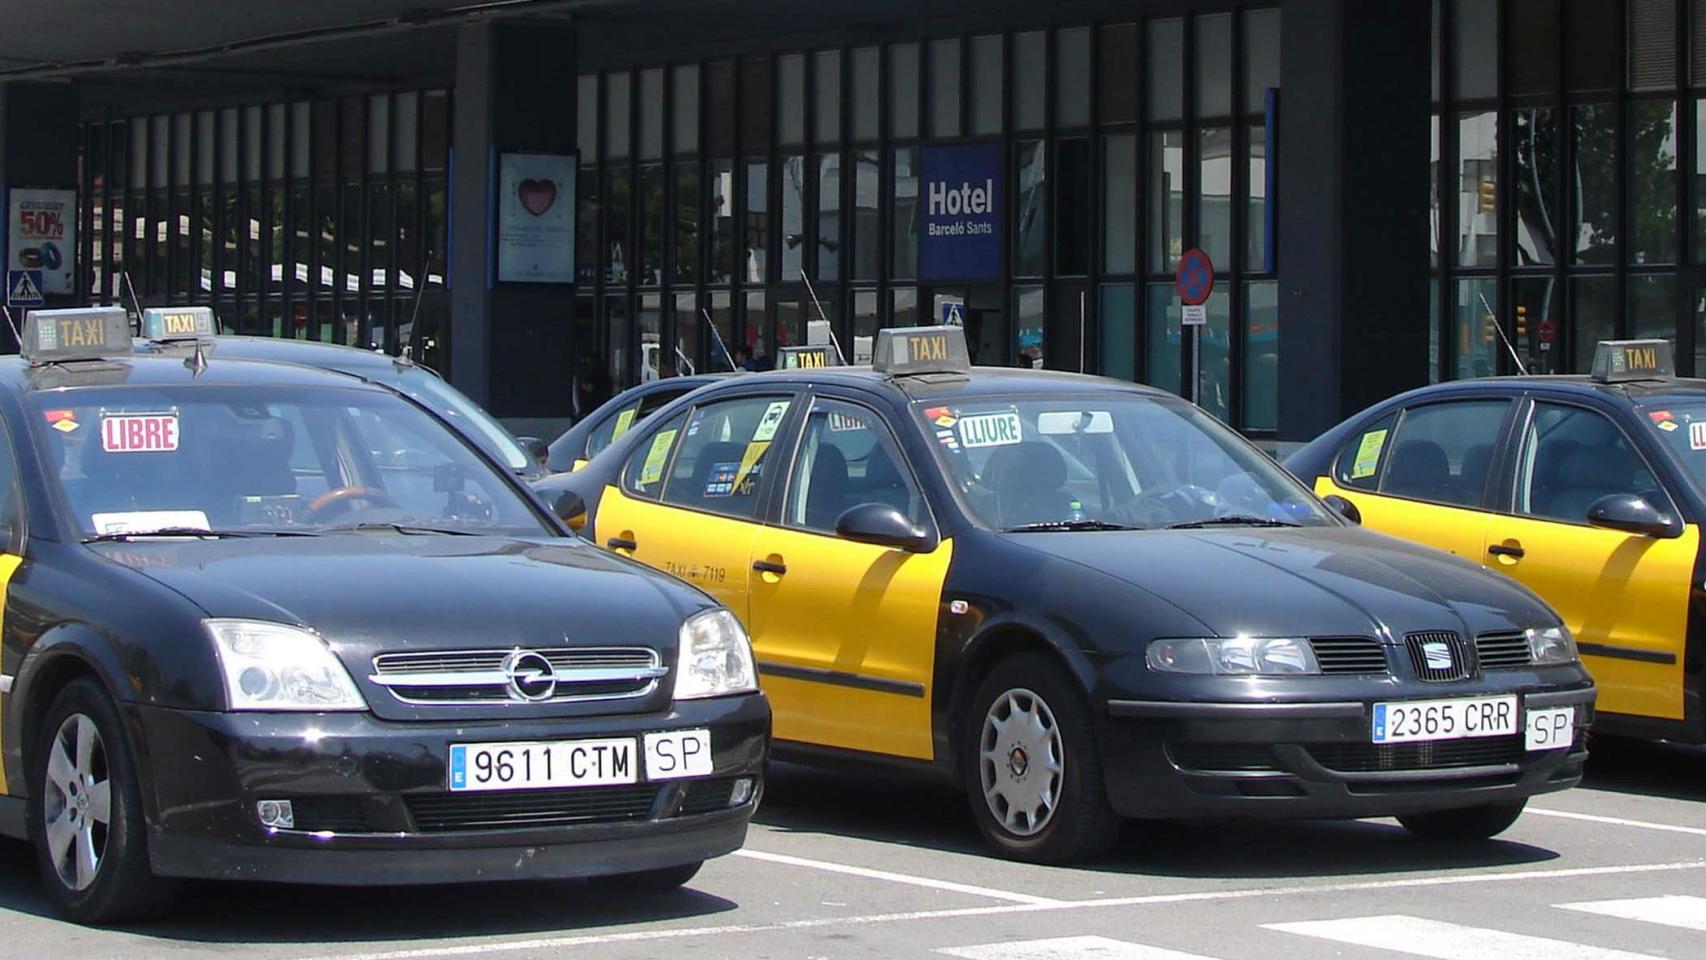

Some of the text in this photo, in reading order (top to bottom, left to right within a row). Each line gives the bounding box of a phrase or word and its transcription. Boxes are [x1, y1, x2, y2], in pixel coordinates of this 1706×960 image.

[929, 179, 992, 215] Hotel
[20, 211, 64, 236] 50%
[929, 221, 992, 236] Barceló Sants
[60, 320, 105, 346] TAXI
[165, 315, 196, 333] TAXI
[799, 353, 825, 369] TAXI
[911, 336, 947, 361] TAXI
[1626, 348, 1656, 370] TAXI
[106, 419, 175, 450] LIBRE
[964, 416, 1018, 444] LLIURE
[1391, 705, 1455, 737] 2365
[1465, 702, 1510, 732] CRR
[1534, 714, 1567, 744] SP
[454, 745, 629, 783] E 9611 CTM
[655, 737, 701, 772] SP
